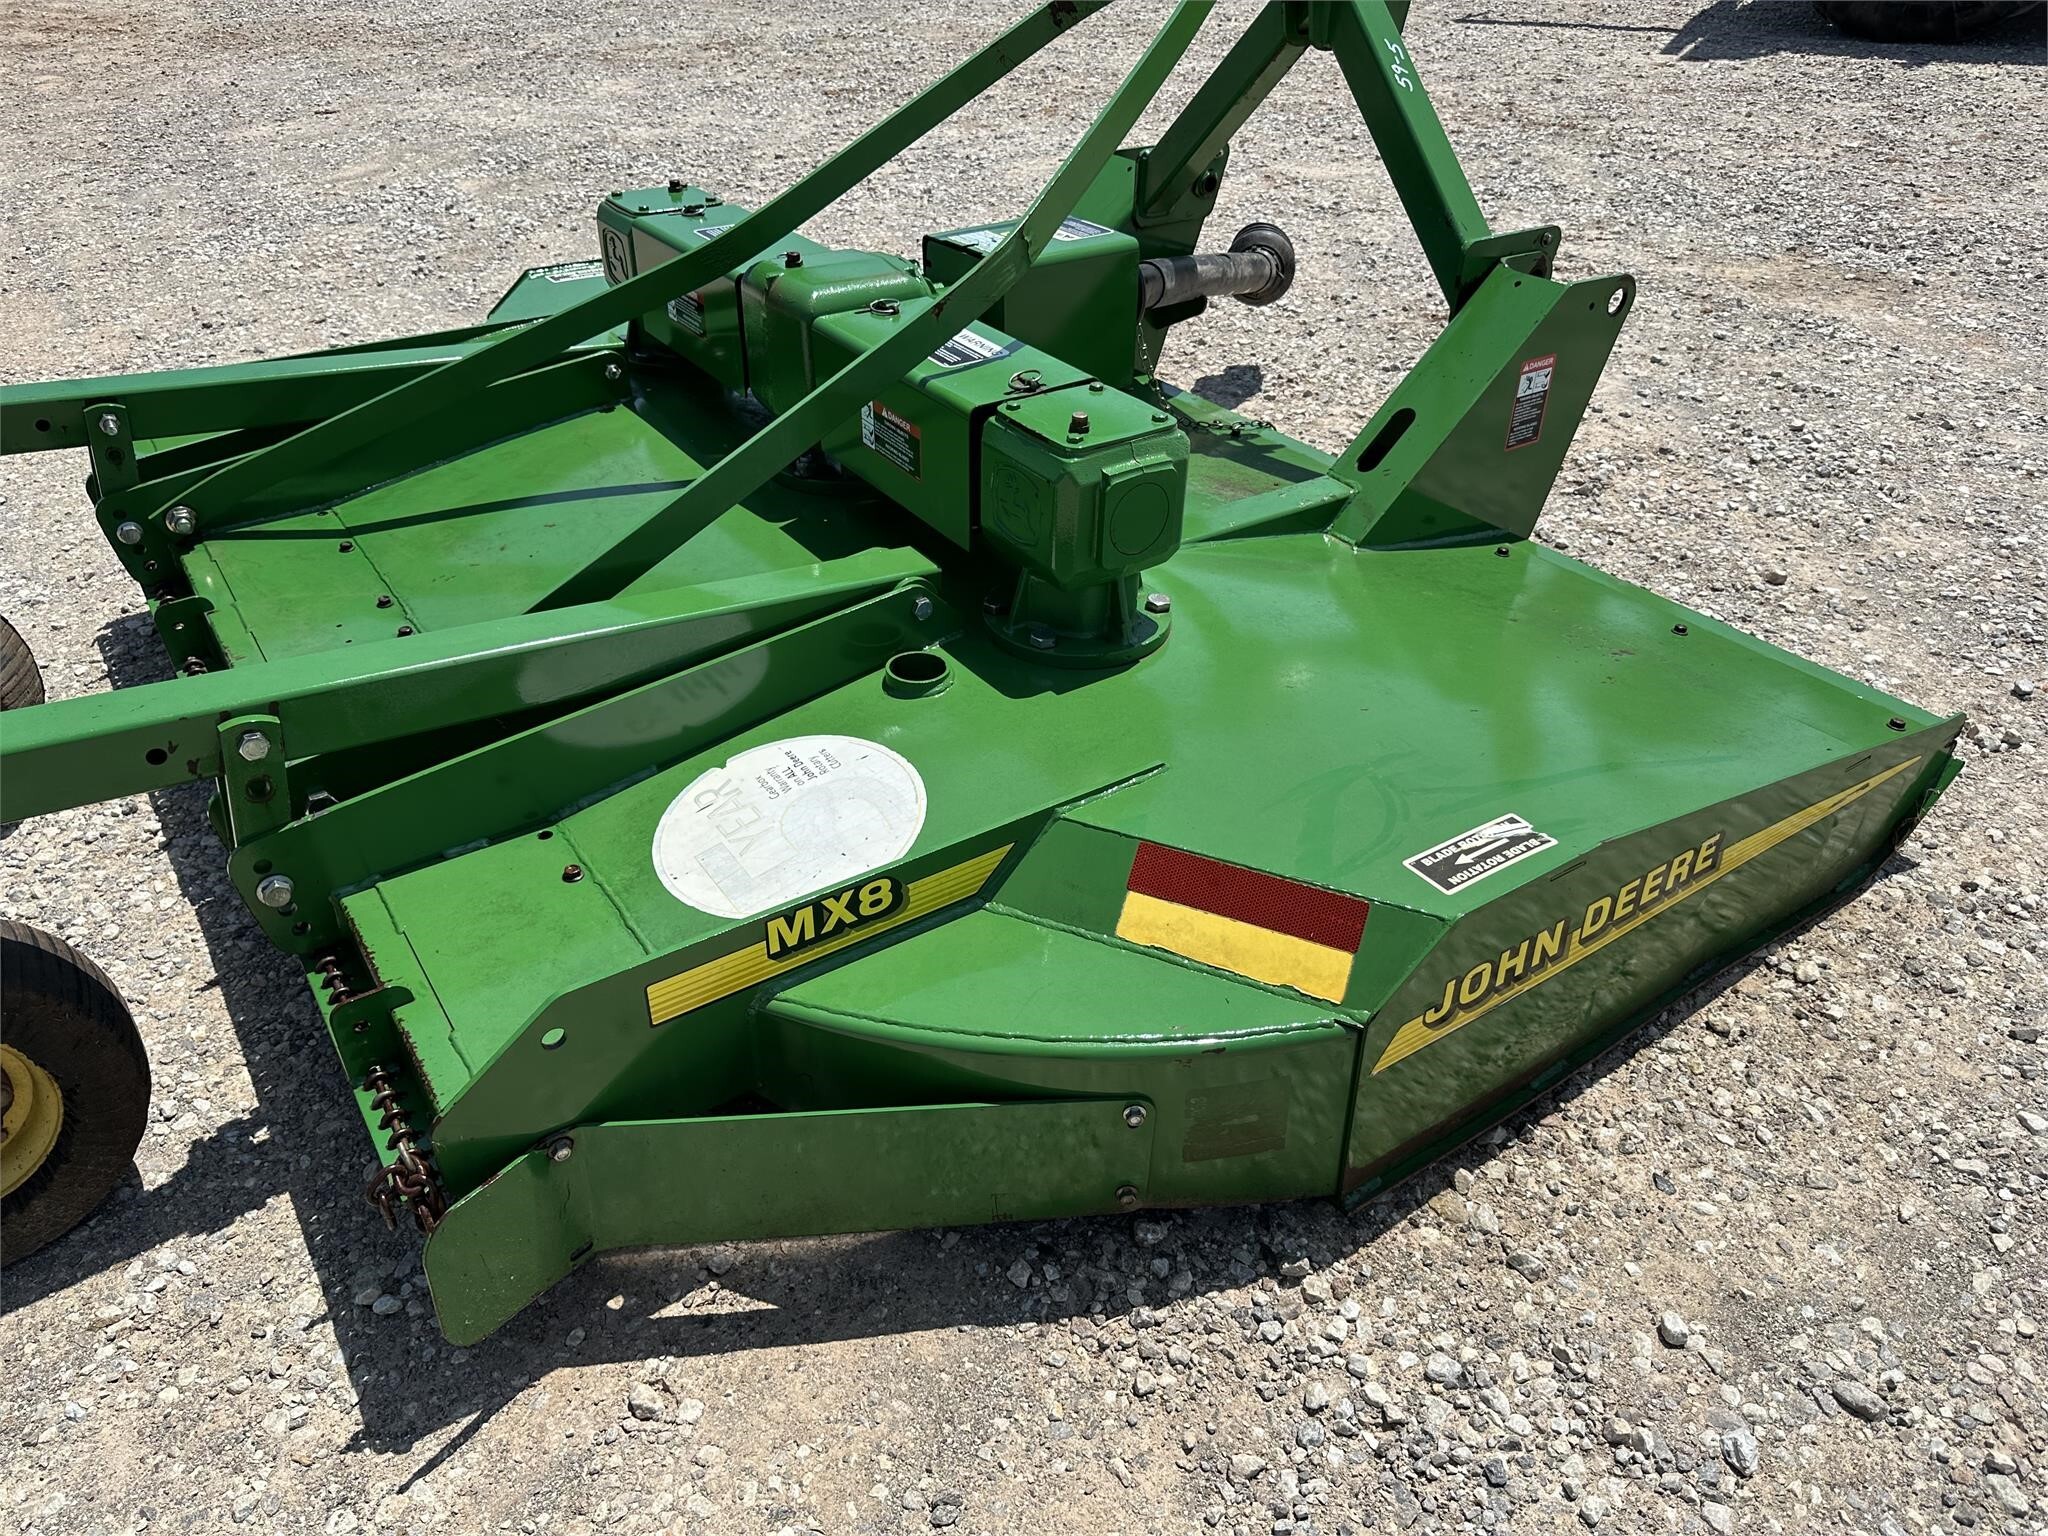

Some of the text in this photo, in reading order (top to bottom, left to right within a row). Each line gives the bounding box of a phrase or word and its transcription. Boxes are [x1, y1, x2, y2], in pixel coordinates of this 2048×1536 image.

[1384, 38, 1413, 92] 59-5
[1529, 357, 1554, 370] DANGER
[887, 410, 911, 432] DANGER
[784, 749, 818, 781] John Deere
[809, 755, 829, 775] Rotary
[818, 748, 842, 770] Cutters
[755, 775, 780, 800] Gearbox
[765, 766, 793, 793] Warranty
[781, 766, 805, 786] on ALL
[694, 778, 774, 856] YEAR
[1420, 845, 1458, 867] BLADE
[1447, 837, 1541, 885] BLADE ROTATION
[765, 877, 896, 957] MX8
[1423, 833, 1722, 1025] JOHN DEERE
